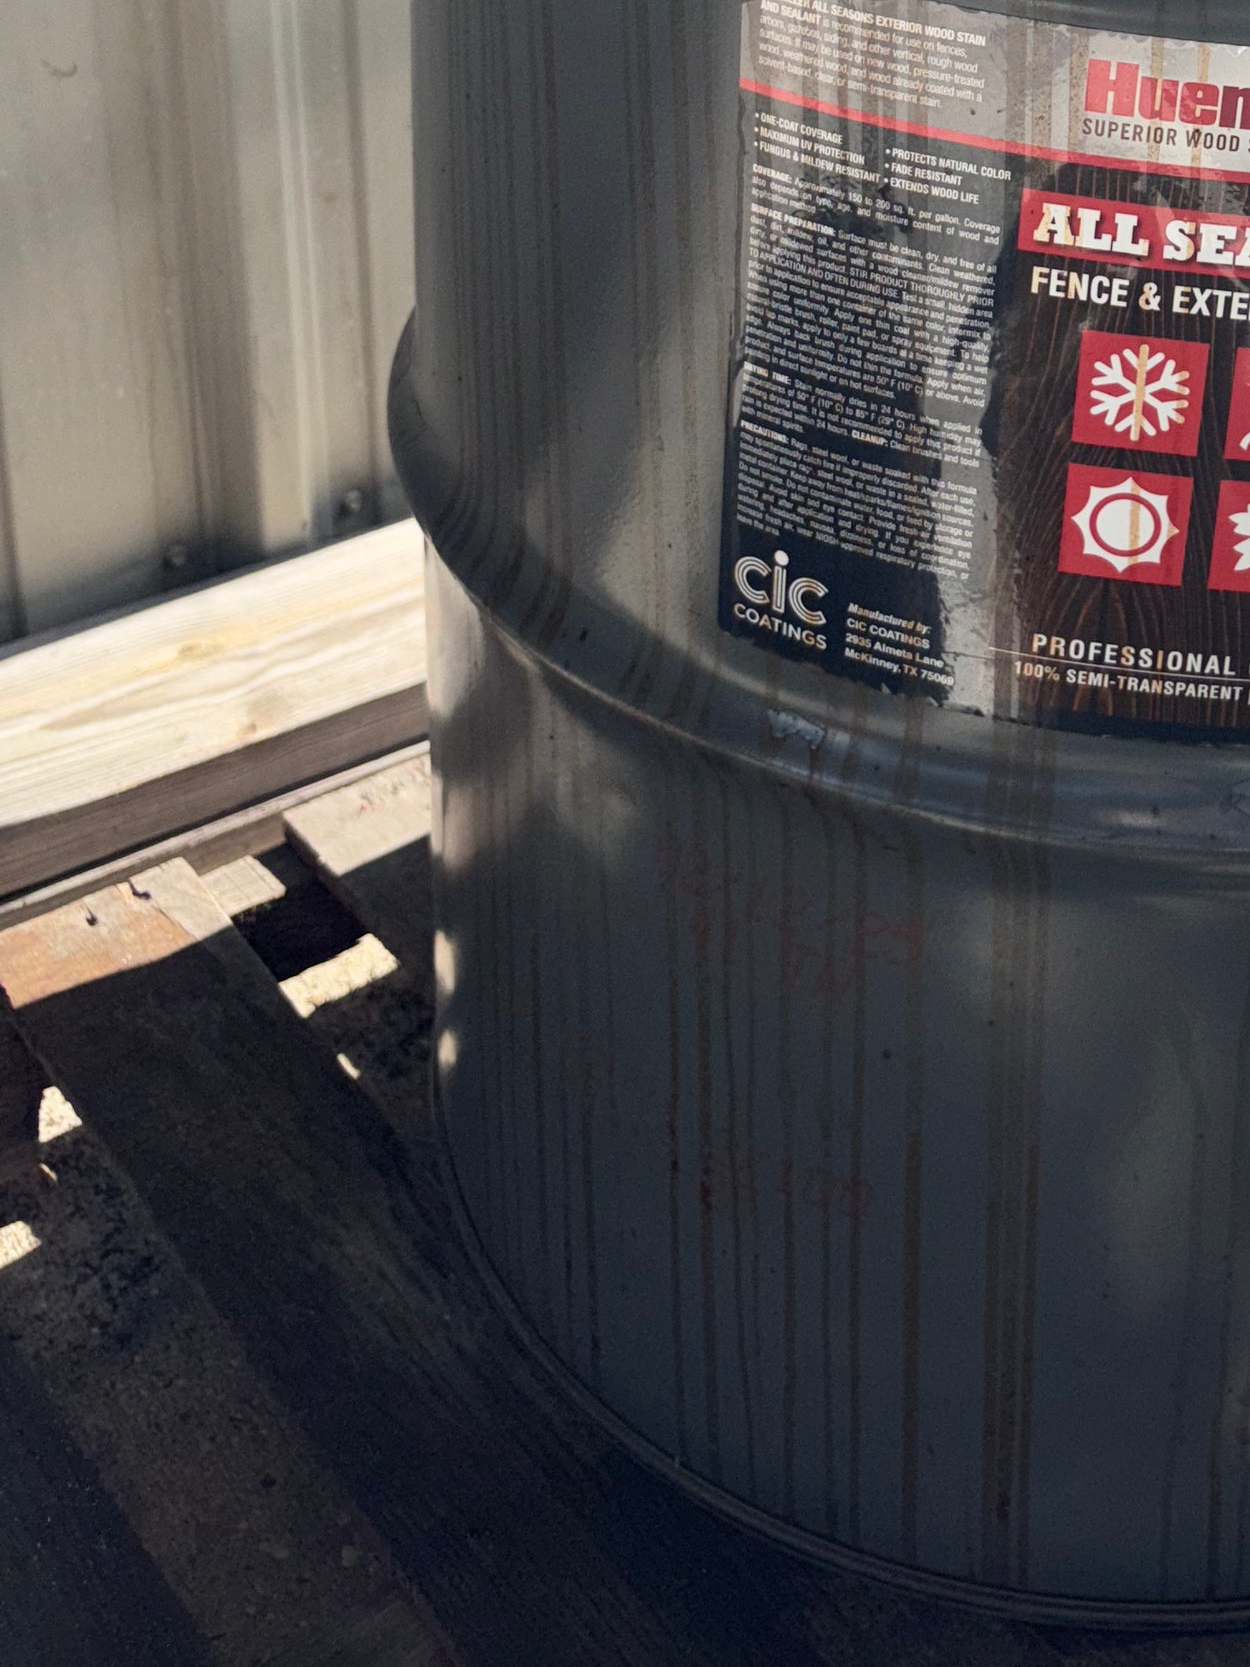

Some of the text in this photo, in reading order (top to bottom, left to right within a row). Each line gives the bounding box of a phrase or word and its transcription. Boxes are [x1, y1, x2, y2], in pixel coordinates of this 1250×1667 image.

[760, 0, 968, 58] AND SEALANT is recommended for use on fences,
[812, 0, 829, 13] ALL
[831, 4, 874, 25] SEASONS
[876, 16, 923, 35] EXTERIOR
[925, 25, 955, 41] WOOD
[957, 31, 986, 47] STAIN
[869, 43, 891, 56] other
[954, 61, 978, 74] wood
[869, 71, 891, 84] wood
[893, 76, 924, 92] already
[925, 83, 954, 97] coated
[914, 67, 985, 89] pressure-treated
[760, 127, 865, 165] MAXIMUM UV PROTECTION
[761, 113, 843, 144] ONE-COAT COVERAGE
[1082, 118, 1177, 146] SUPERIOR
[1185, 131, 1239, 152] WOOD
[760, 141, 880, 183] FUNGUS & MILDEW RESISTANT
[891, 163, 962, 185] FADE RESISTANT
[892, 148, 1011, 181] PROTECTS NATURAL COLOR
[890, 177, 979, 205] EXTENDS WOOD LIFE
[1033, 202, 1149, 256] ALL
[1030, 266, 1130, 308] FENCE
[1139, 282, 1161, 310] &
[734, 603, 827, 651] COATINGS
[847, 618, 930, 649] CIC COATINGS
[848, 603, 915, 629] Manufactured
[845, 648, 954, 686] McKinney, TX 75069
[846, 633, 944, 668] 2935 Almeta Lane
[1032, 633, 1235, 675] PROFESSIONAL
[1014, 660, 1059, 681] 100%
[1066, 668, 1243, 701] SEMI-TRANSPARENT
